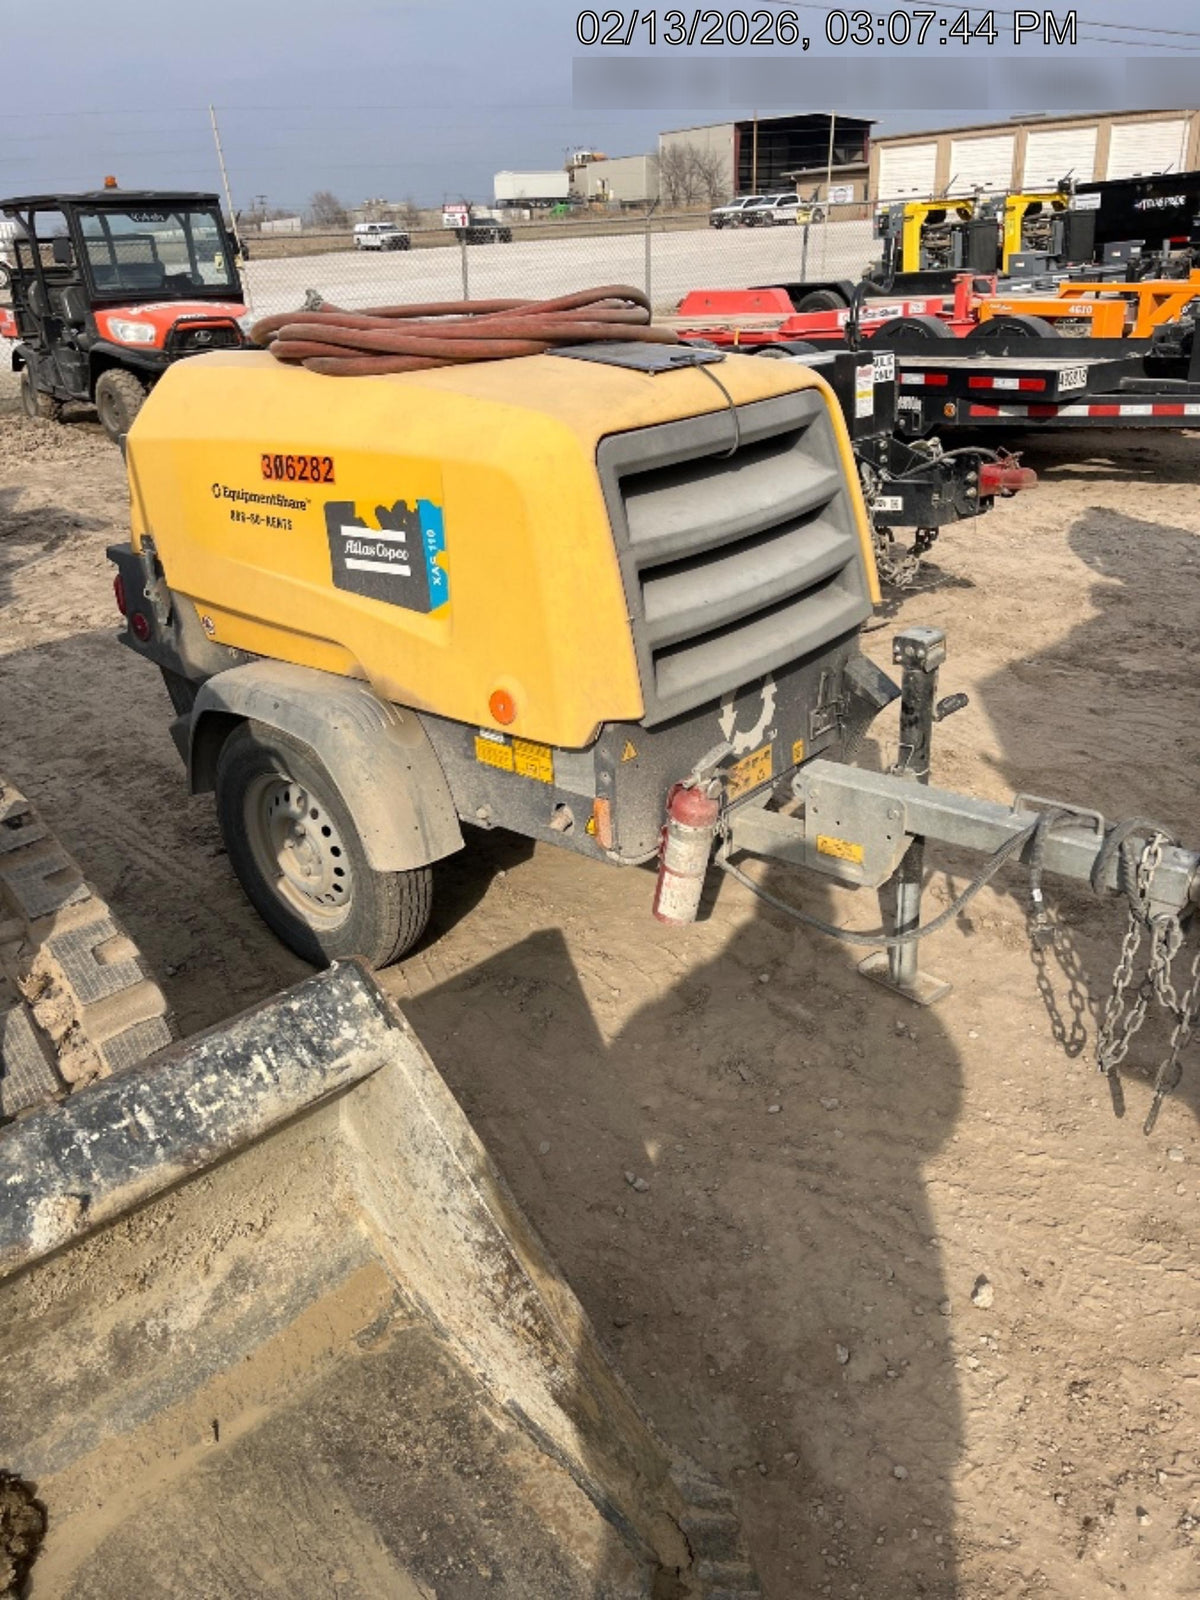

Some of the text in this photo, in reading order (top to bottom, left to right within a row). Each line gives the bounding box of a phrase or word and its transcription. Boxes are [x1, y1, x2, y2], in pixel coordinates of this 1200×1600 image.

[262, 454, 335, 483] 306282
[344, 540, 410, 562] Atlas Copco
